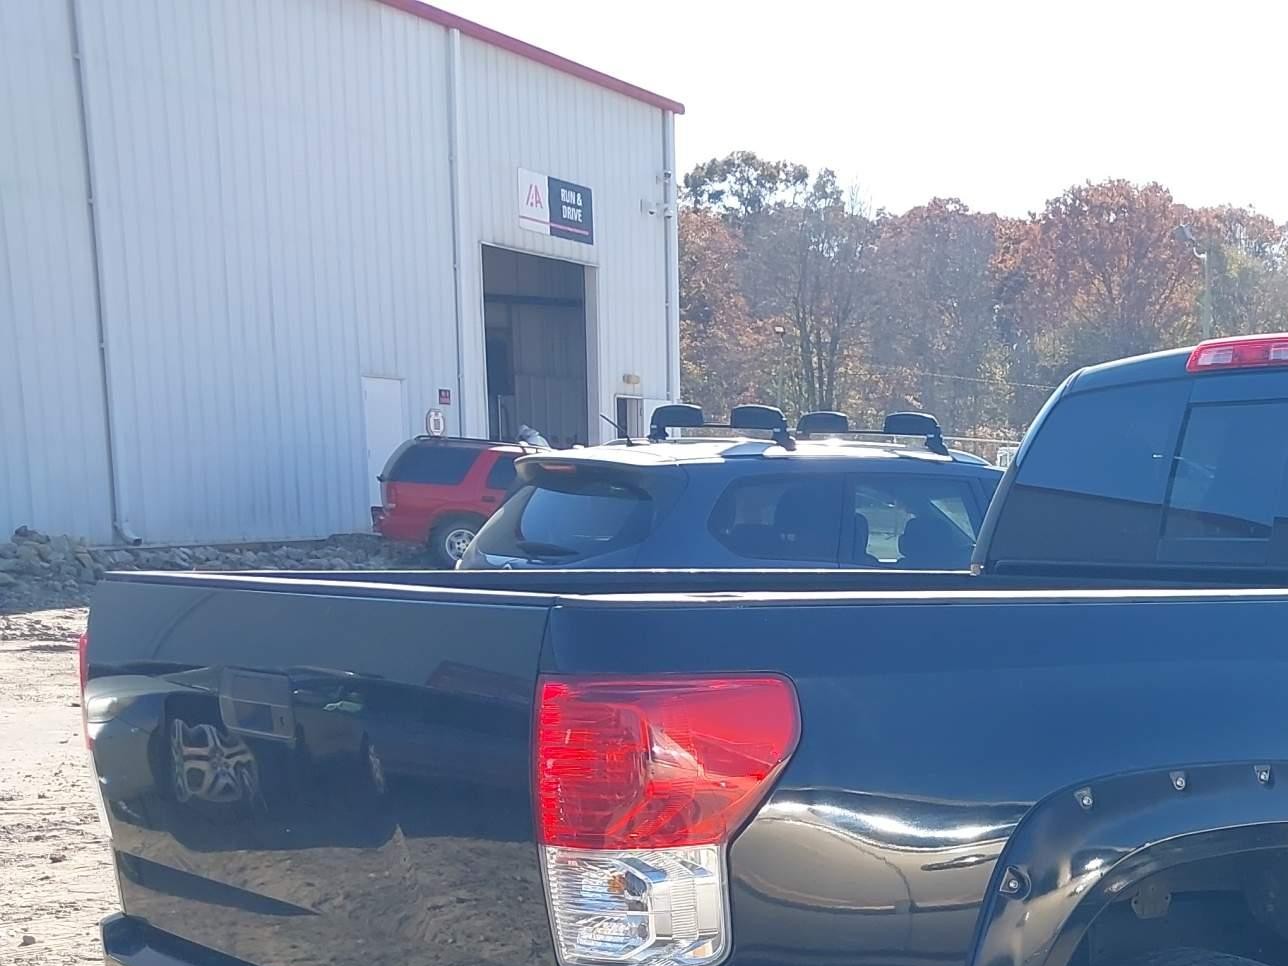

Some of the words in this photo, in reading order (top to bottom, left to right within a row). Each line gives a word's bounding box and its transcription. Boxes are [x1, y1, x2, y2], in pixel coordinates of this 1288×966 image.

[560, 188, 576, 205] RUN
[576, 192, 583, 206] &
[562, 205, 583, 223] DRIVE
